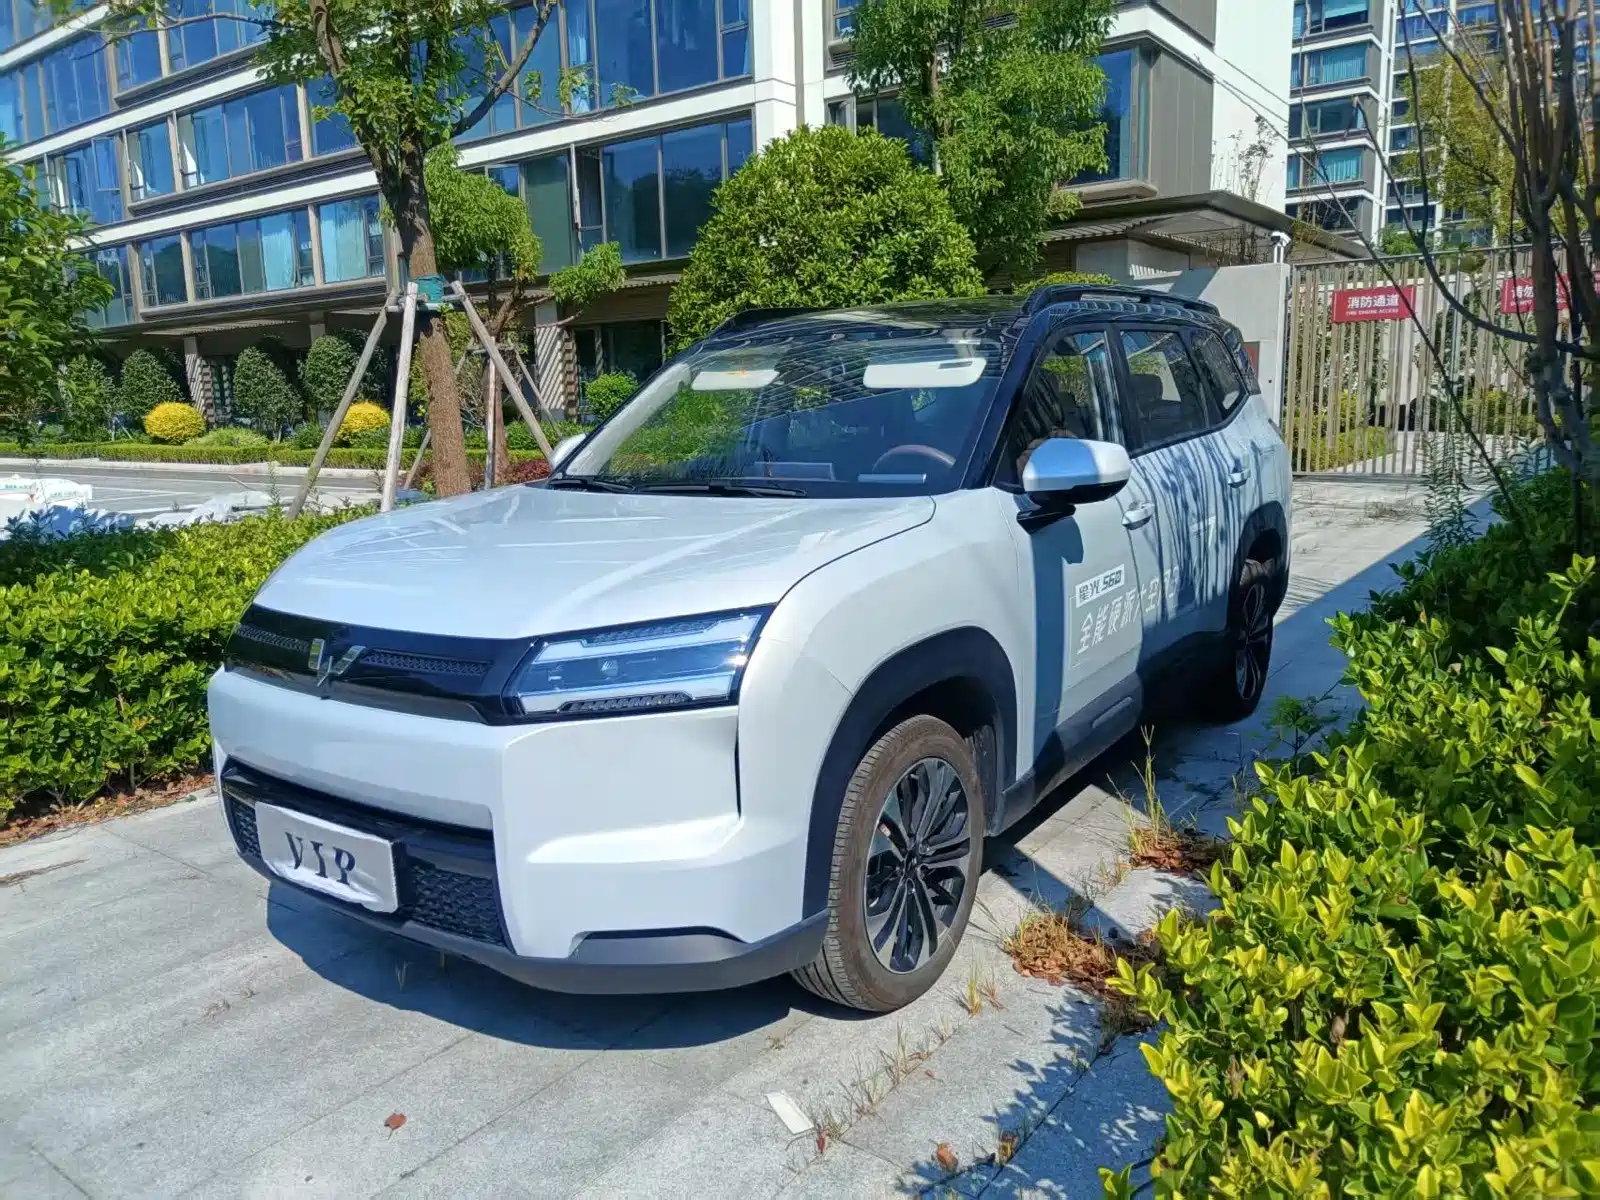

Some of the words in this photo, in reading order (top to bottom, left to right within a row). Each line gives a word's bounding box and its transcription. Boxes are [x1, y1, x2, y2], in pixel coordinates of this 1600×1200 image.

[1347, 293, 1399, 309] 消防通道
[284, 831, 356, 886] VIP
